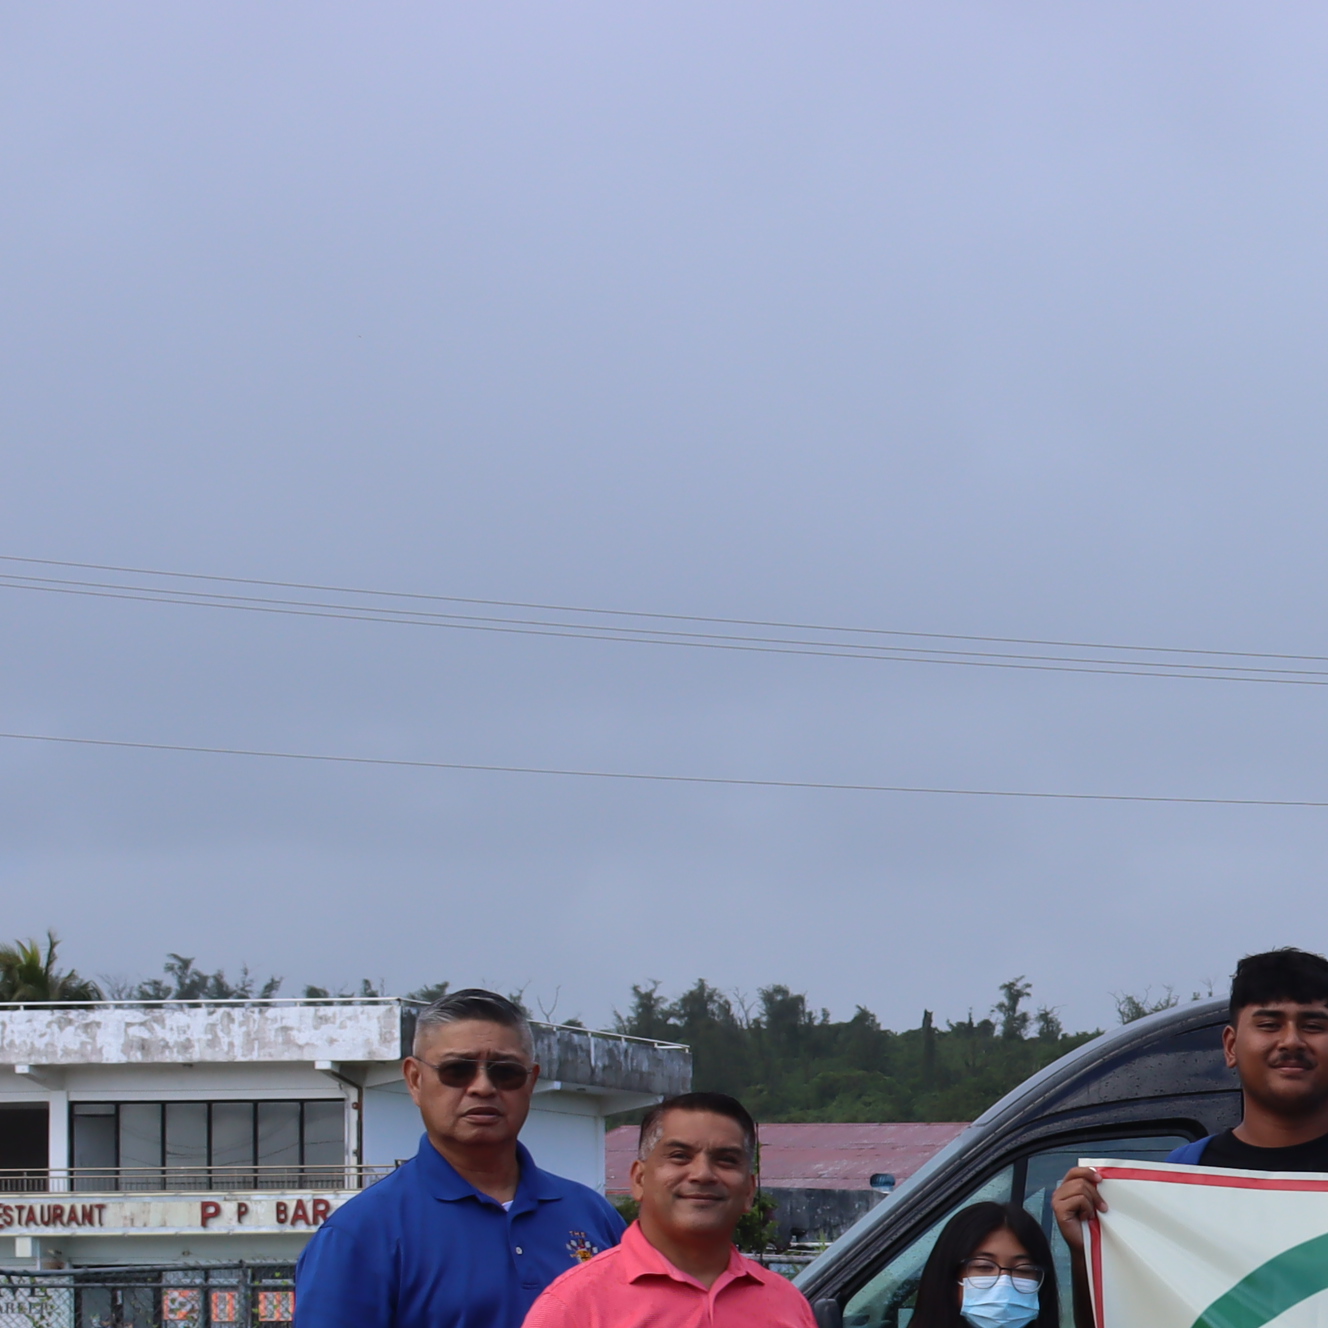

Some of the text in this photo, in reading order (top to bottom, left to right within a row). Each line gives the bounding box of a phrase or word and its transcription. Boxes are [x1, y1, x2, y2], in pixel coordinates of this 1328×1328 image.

[201, 1201, 220, 1227] P
[237, 1202, 249, 1223] P
[276, 1199, 331, 1226] BAR
